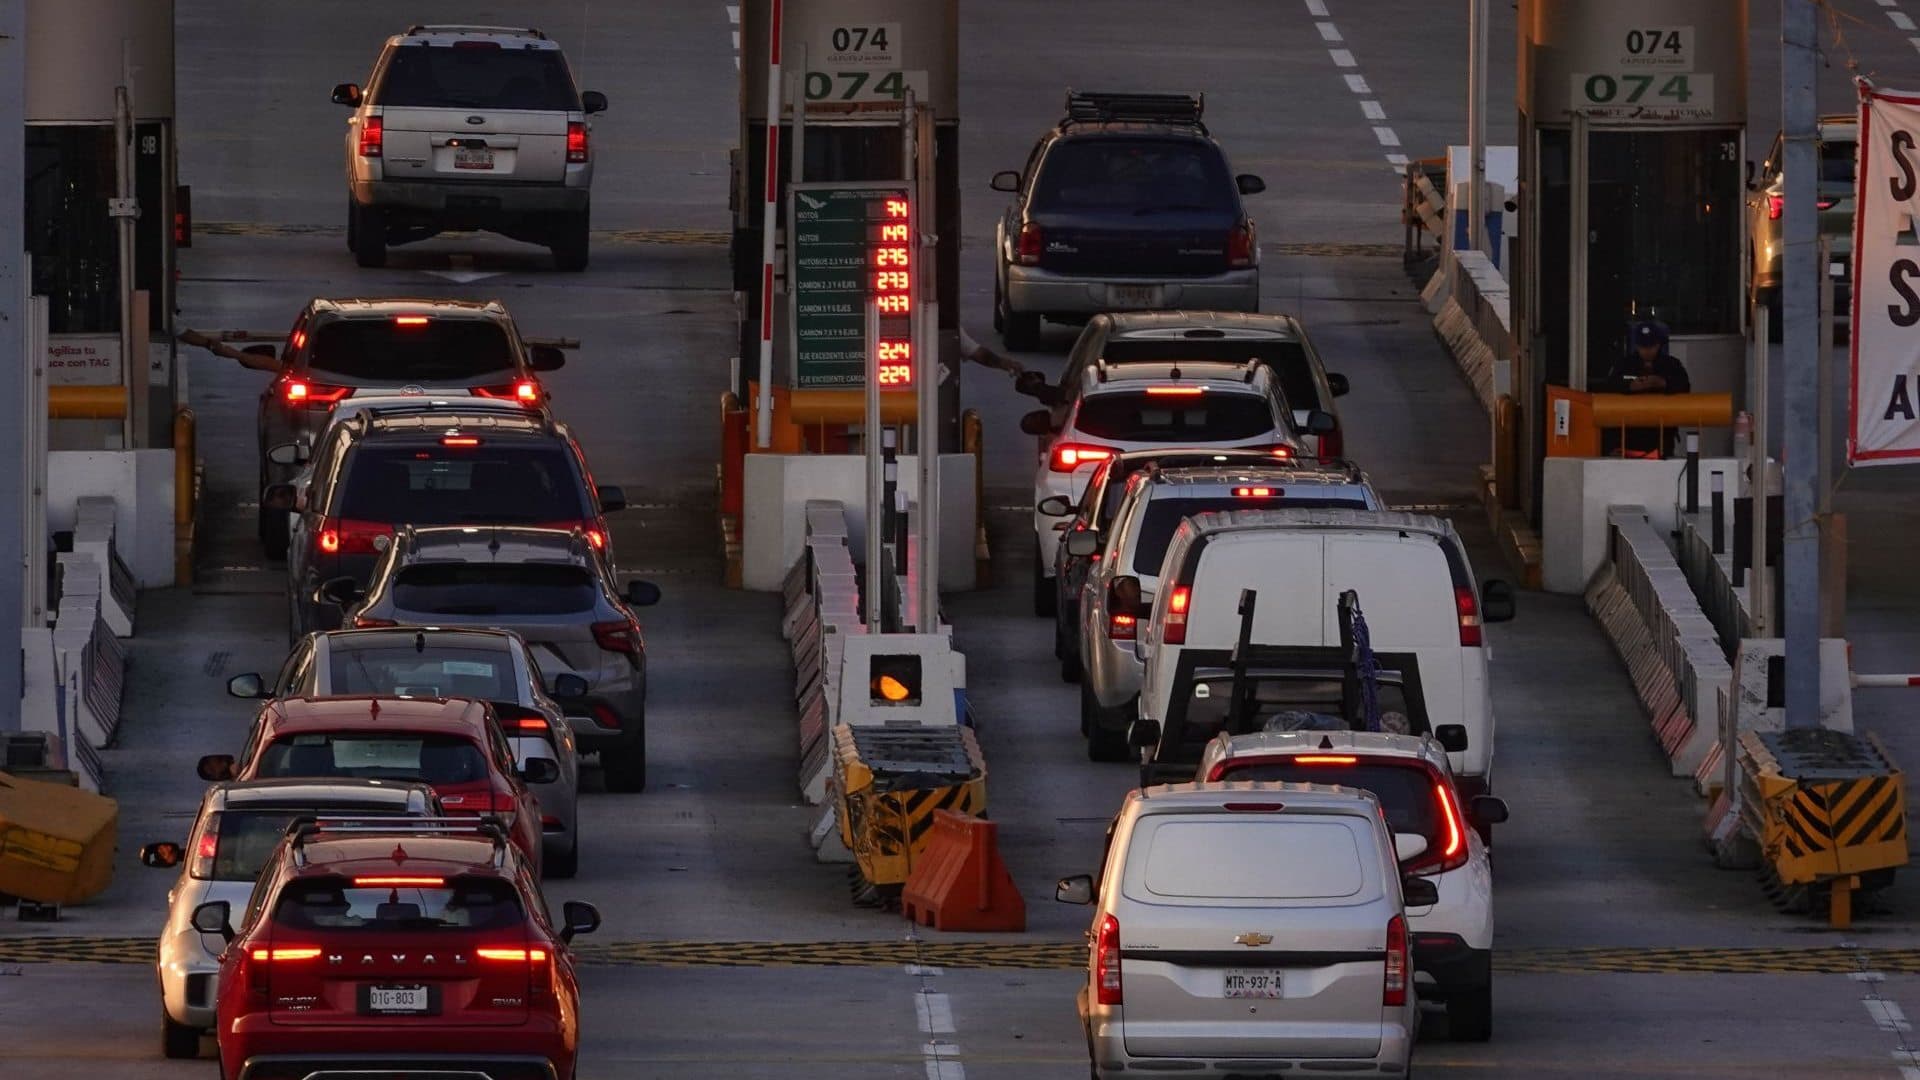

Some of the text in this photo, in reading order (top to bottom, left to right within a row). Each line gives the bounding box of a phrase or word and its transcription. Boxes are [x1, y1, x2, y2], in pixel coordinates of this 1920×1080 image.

[832, 27, 889, 52] 074
[1625, 29, 1683, 55] 074
[804, 71, 908, 100] 074
[1584, 74, 1693, 103] 074
[886, 200, 908, 218] 74
[882, 224, 908, 241] 149
[84, 347, 96, 355] tu
[67, 361, 86, 369] con
[89, 359, 110, 368] TAG
[879, 366, 911, 384] 229
[1883, 374, 1920, 420] A
[329, 954, 468, 964] HAVAL
[1226, 975, 1281, 989] MTR-937-A
